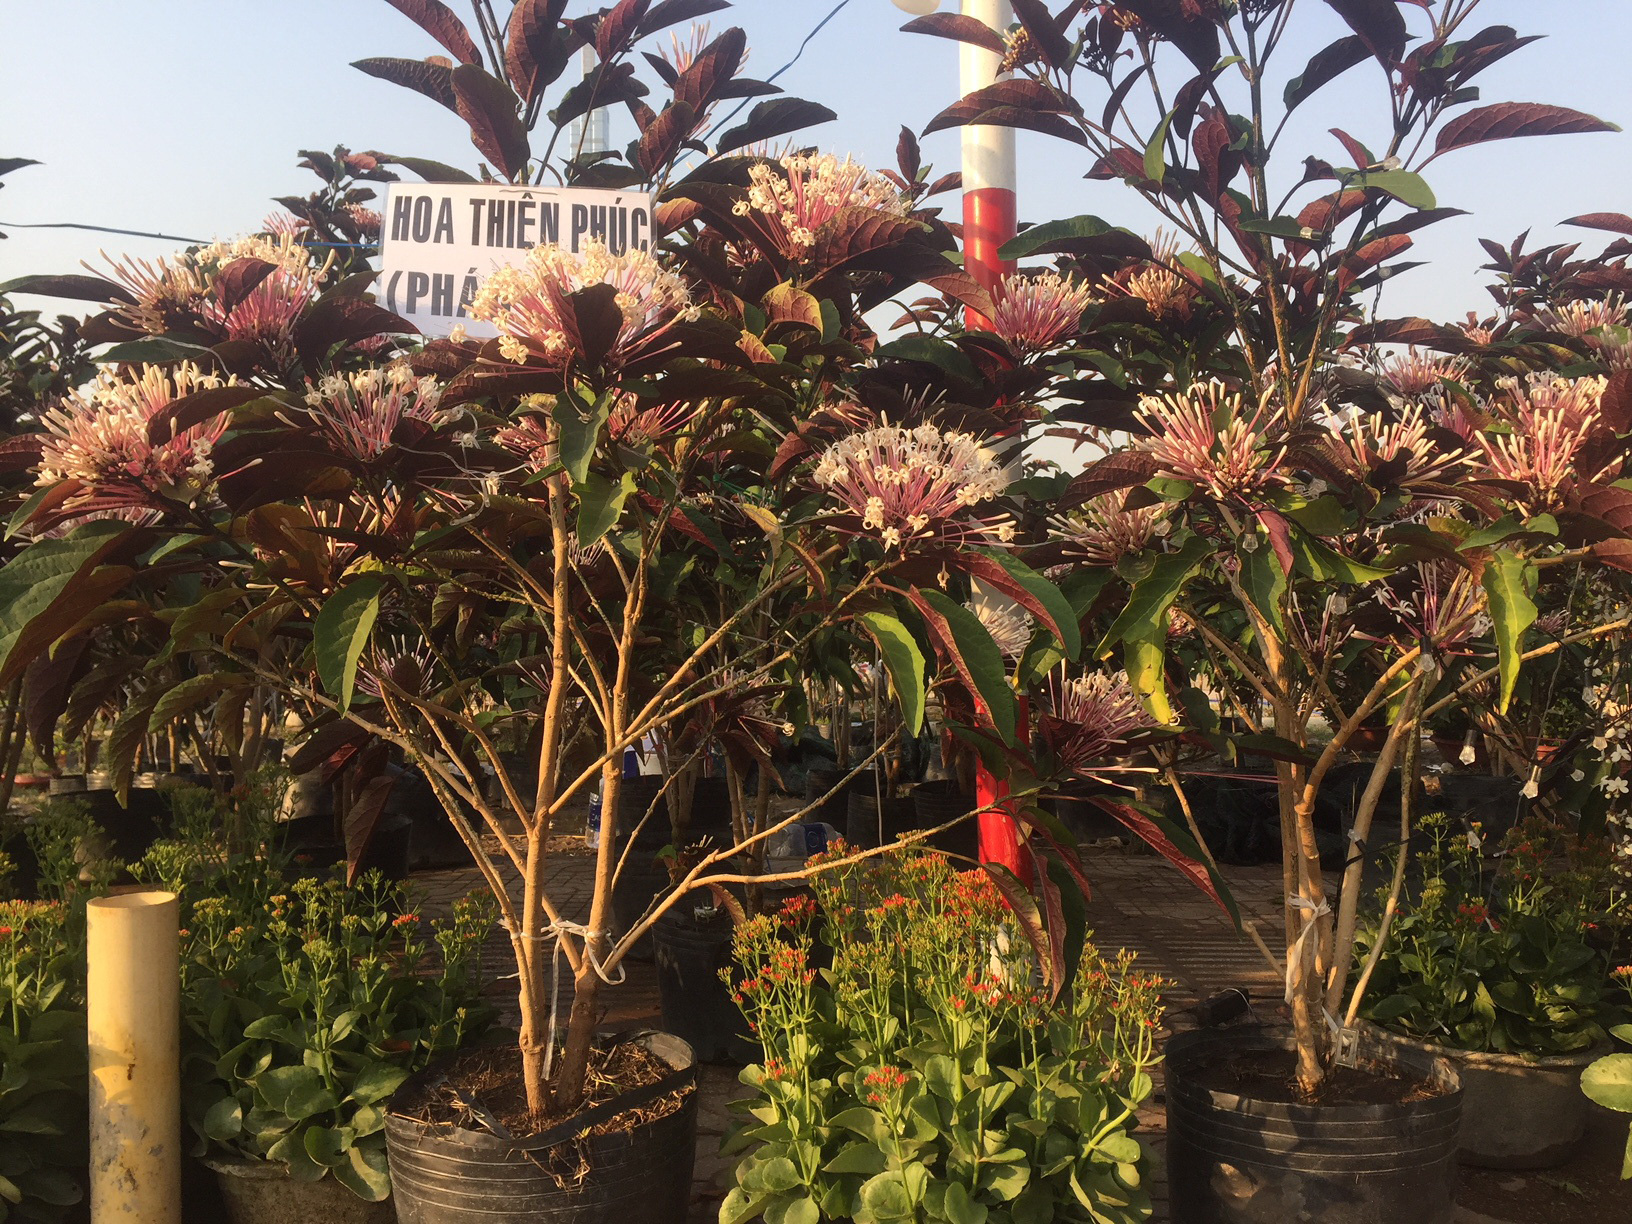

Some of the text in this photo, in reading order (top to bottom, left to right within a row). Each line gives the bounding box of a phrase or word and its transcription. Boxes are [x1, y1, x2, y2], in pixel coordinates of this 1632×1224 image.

[391, 192, 648, 258] HOA THIÊN PHÚC
[387, 267, 511, 319] (PHÁ
